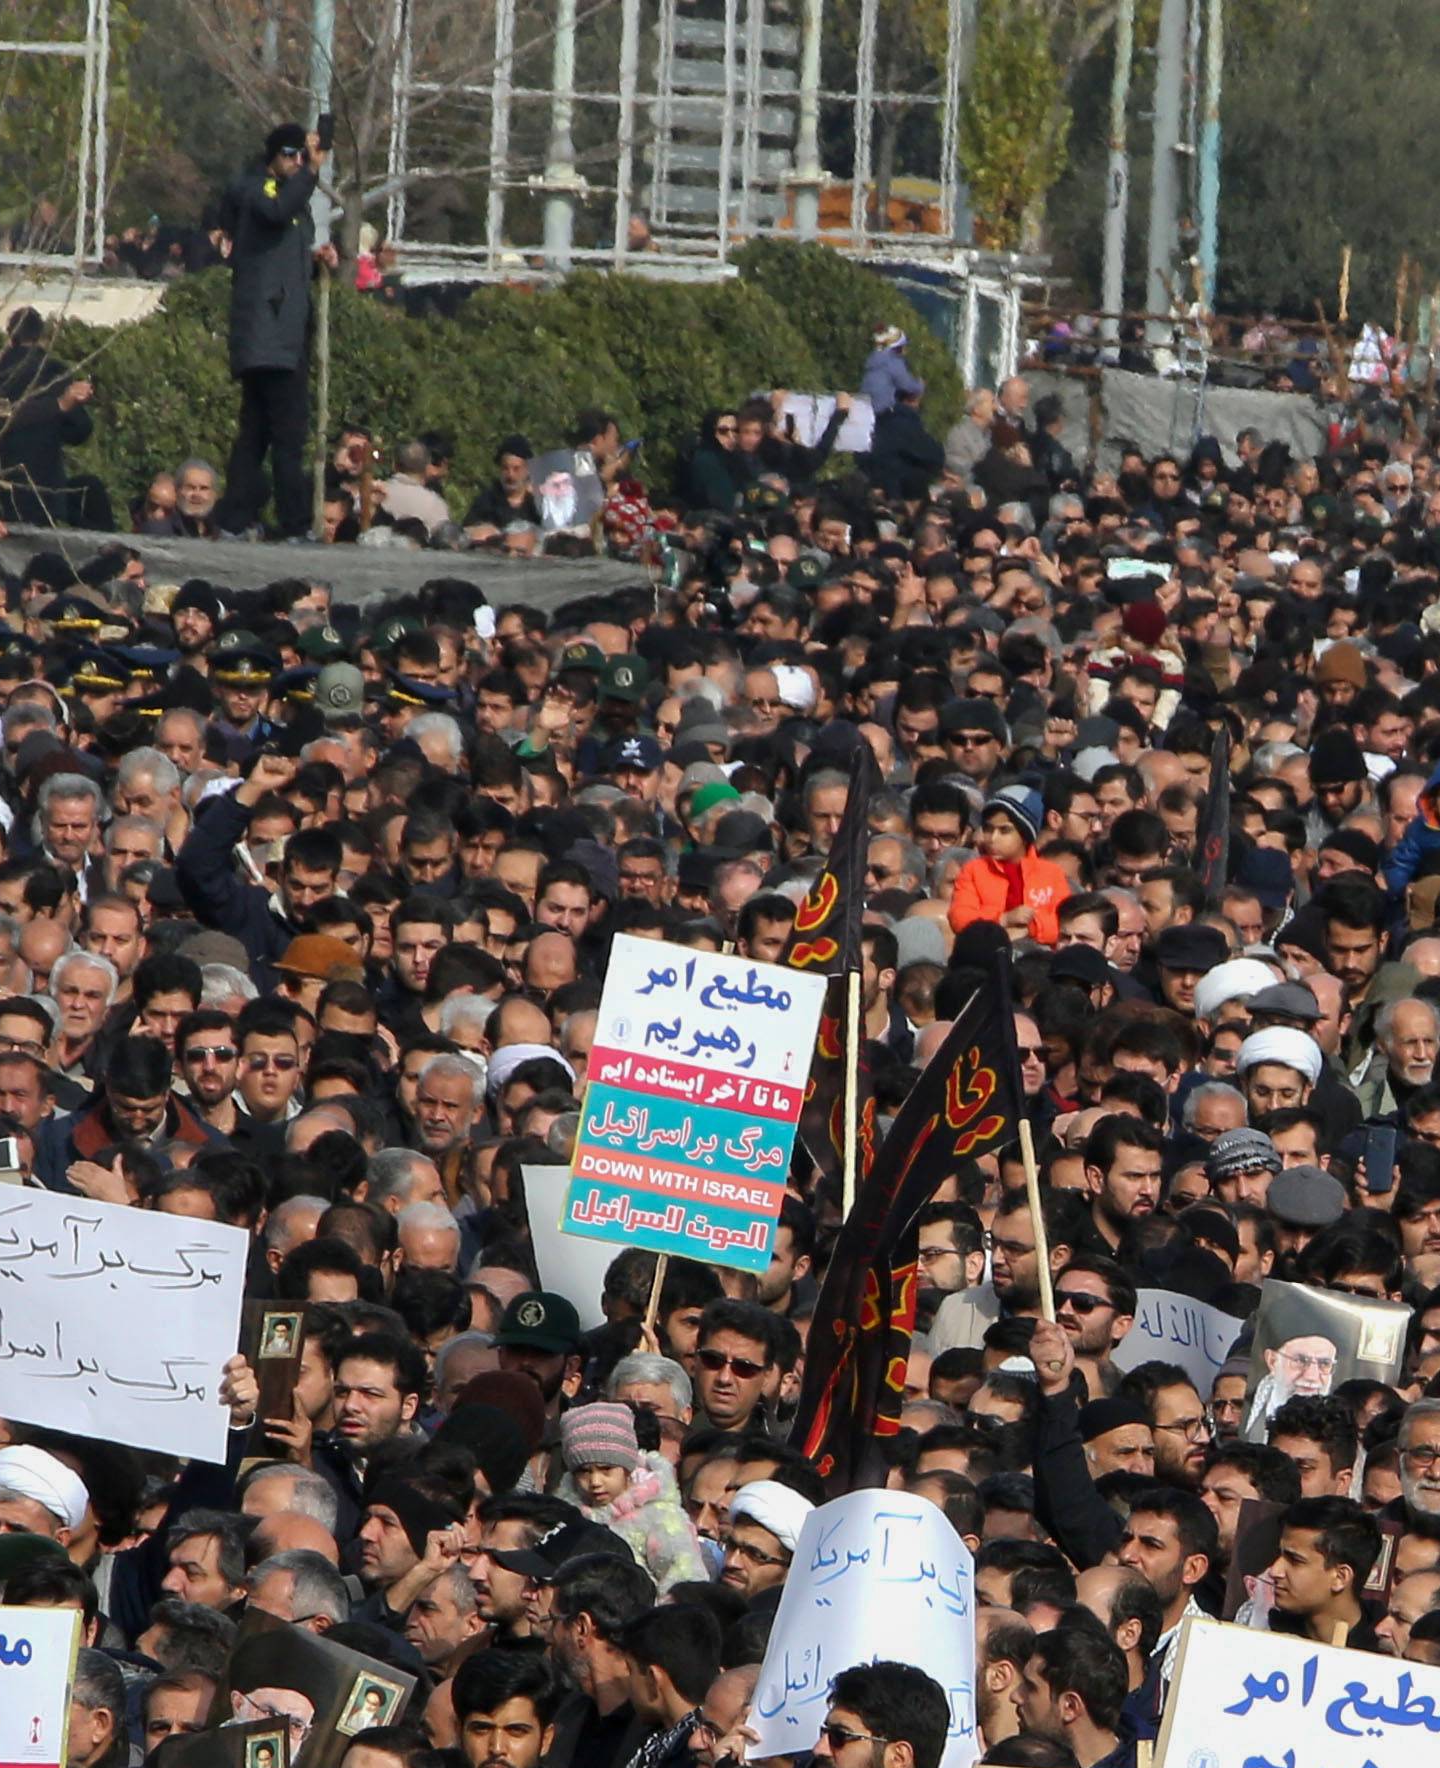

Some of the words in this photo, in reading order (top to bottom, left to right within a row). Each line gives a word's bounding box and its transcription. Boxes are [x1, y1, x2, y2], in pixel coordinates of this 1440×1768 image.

[635, 958, 696, 995] امر
[700, 968, 792, 1012] مطیع
[645, 1017, 757, 1069] رهبریم
[600, 1058, 631, 1082] ایم
[634, 1065, 705, 1097] ایستاده
[705, 1079, 752, 1105] آخر
[753, 1082, 769, 1106] تا
[772, 1089, 790, 1112] ما
[588, 1102, 691, 1149] اسرائیل
[687, 1130, 718, 1165] بر
[725, 1127, 784, 1170] مرگ
[581, 1155, 644, 1184] DOWN
[648, 1169, 700, 1193] WITH
[702, 1177, 774, 1208] ISRAEL
[687, 1216, 769, 1251] الموت
[46, 1249, 125, 1290] بر
[128, 1243, 229, 1290] مرگ
[24, 1356, 99, 1398] بر
[105, 1356, 209, 1401] مرگ
[1224, 1654, 1319, 1716] امر
